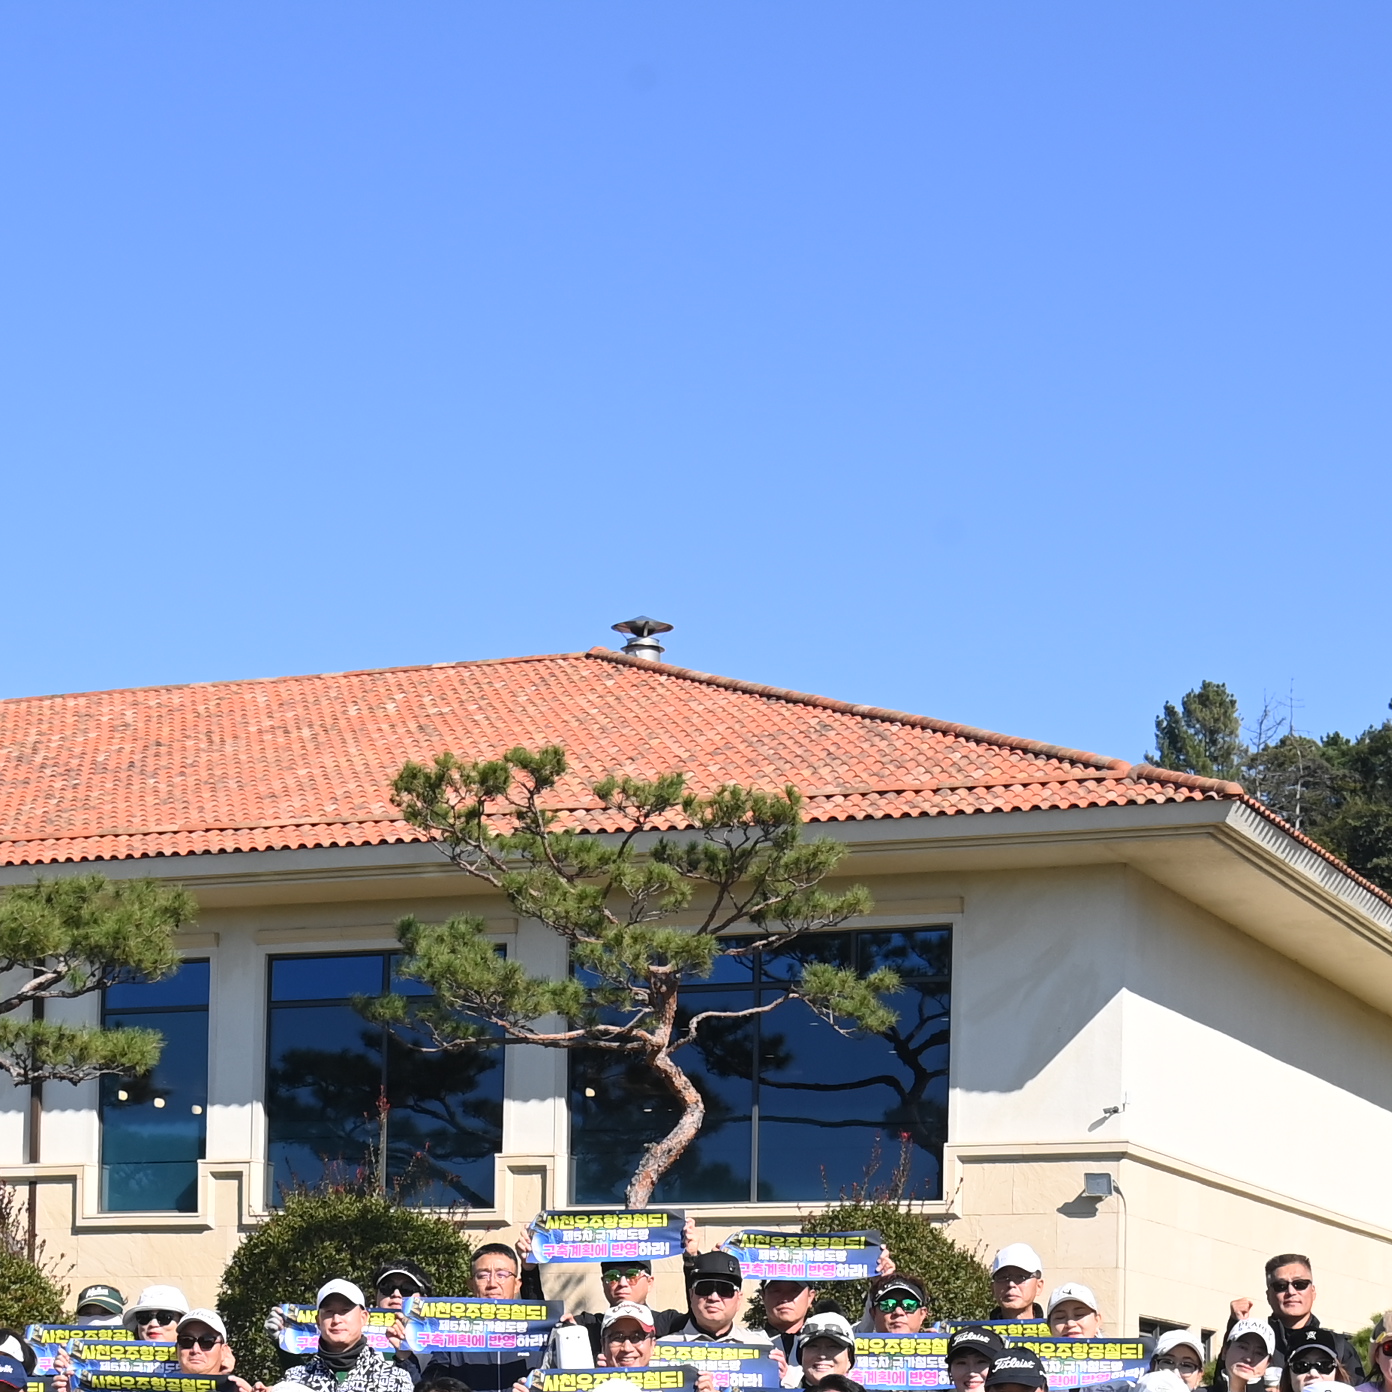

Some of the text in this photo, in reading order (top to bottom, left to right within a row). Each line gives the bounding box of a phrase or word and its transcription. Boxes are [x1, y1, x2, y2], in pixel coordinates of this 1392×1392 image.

[545, 1213, 667, 1229] 사천우주항공철도!
[562, 1229, 649, 1241] 제5차 국가철도망
[541, 1241, 669, 1257] 구축계획에 반영하라!
[757, 1249, 847, 1262] 제5차 국가철도망
[808, 1262, 868, 1278] 반영하라!
[420, 1301, 546, 1320] 사천우주항공철도!
[438, 1318, 527, 1332] 제5차 국가철도망
[416, 1331, 485, 1347] 구축계획에
[952, 1331, 990, 1346] Titleist
[992, 1356, 1034, 1372] Titleist
